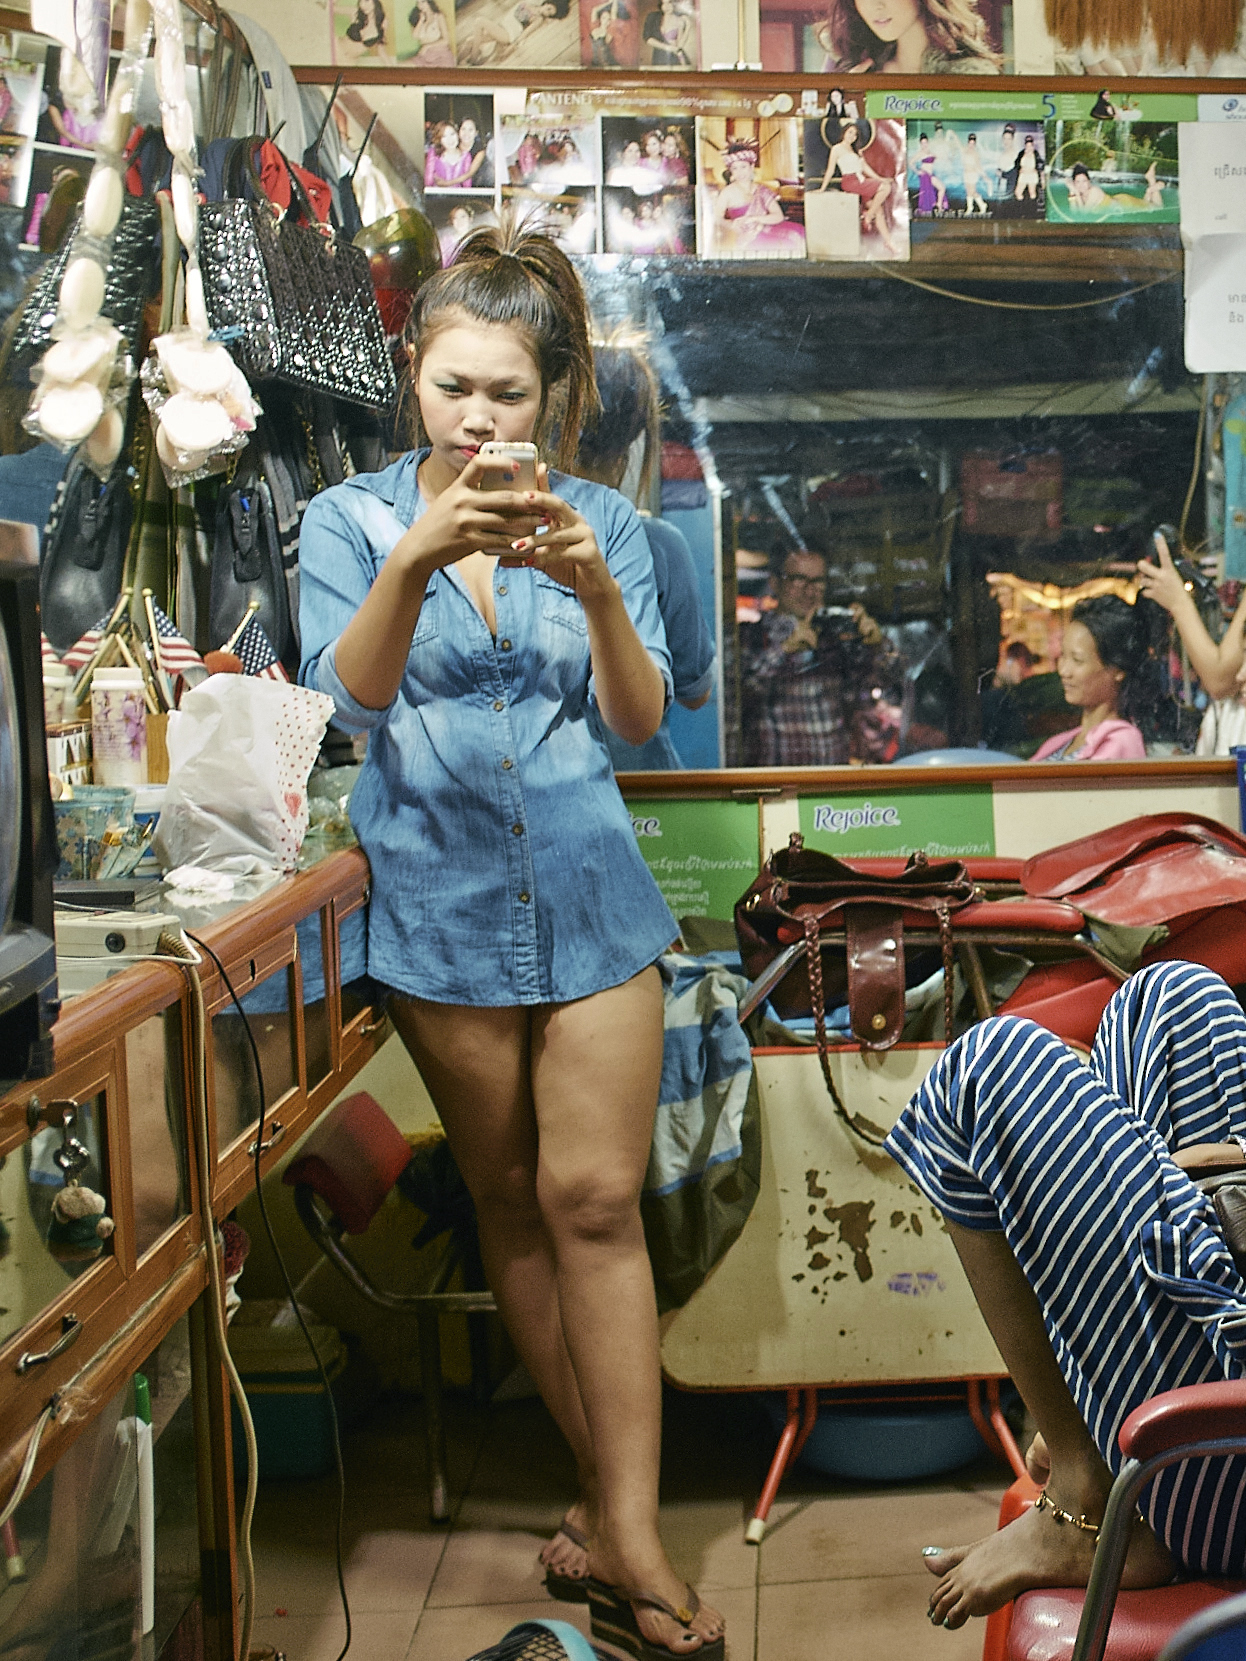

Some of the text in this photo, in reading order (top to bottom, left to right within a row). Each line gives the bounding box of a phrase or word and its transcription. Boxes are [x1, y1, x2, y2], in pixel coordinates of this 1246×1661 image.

[884, 95, 943, 113] Rejoice
[1041, 94, 1056, 119] 5
[814, 802, 900, 833] Rejoice
